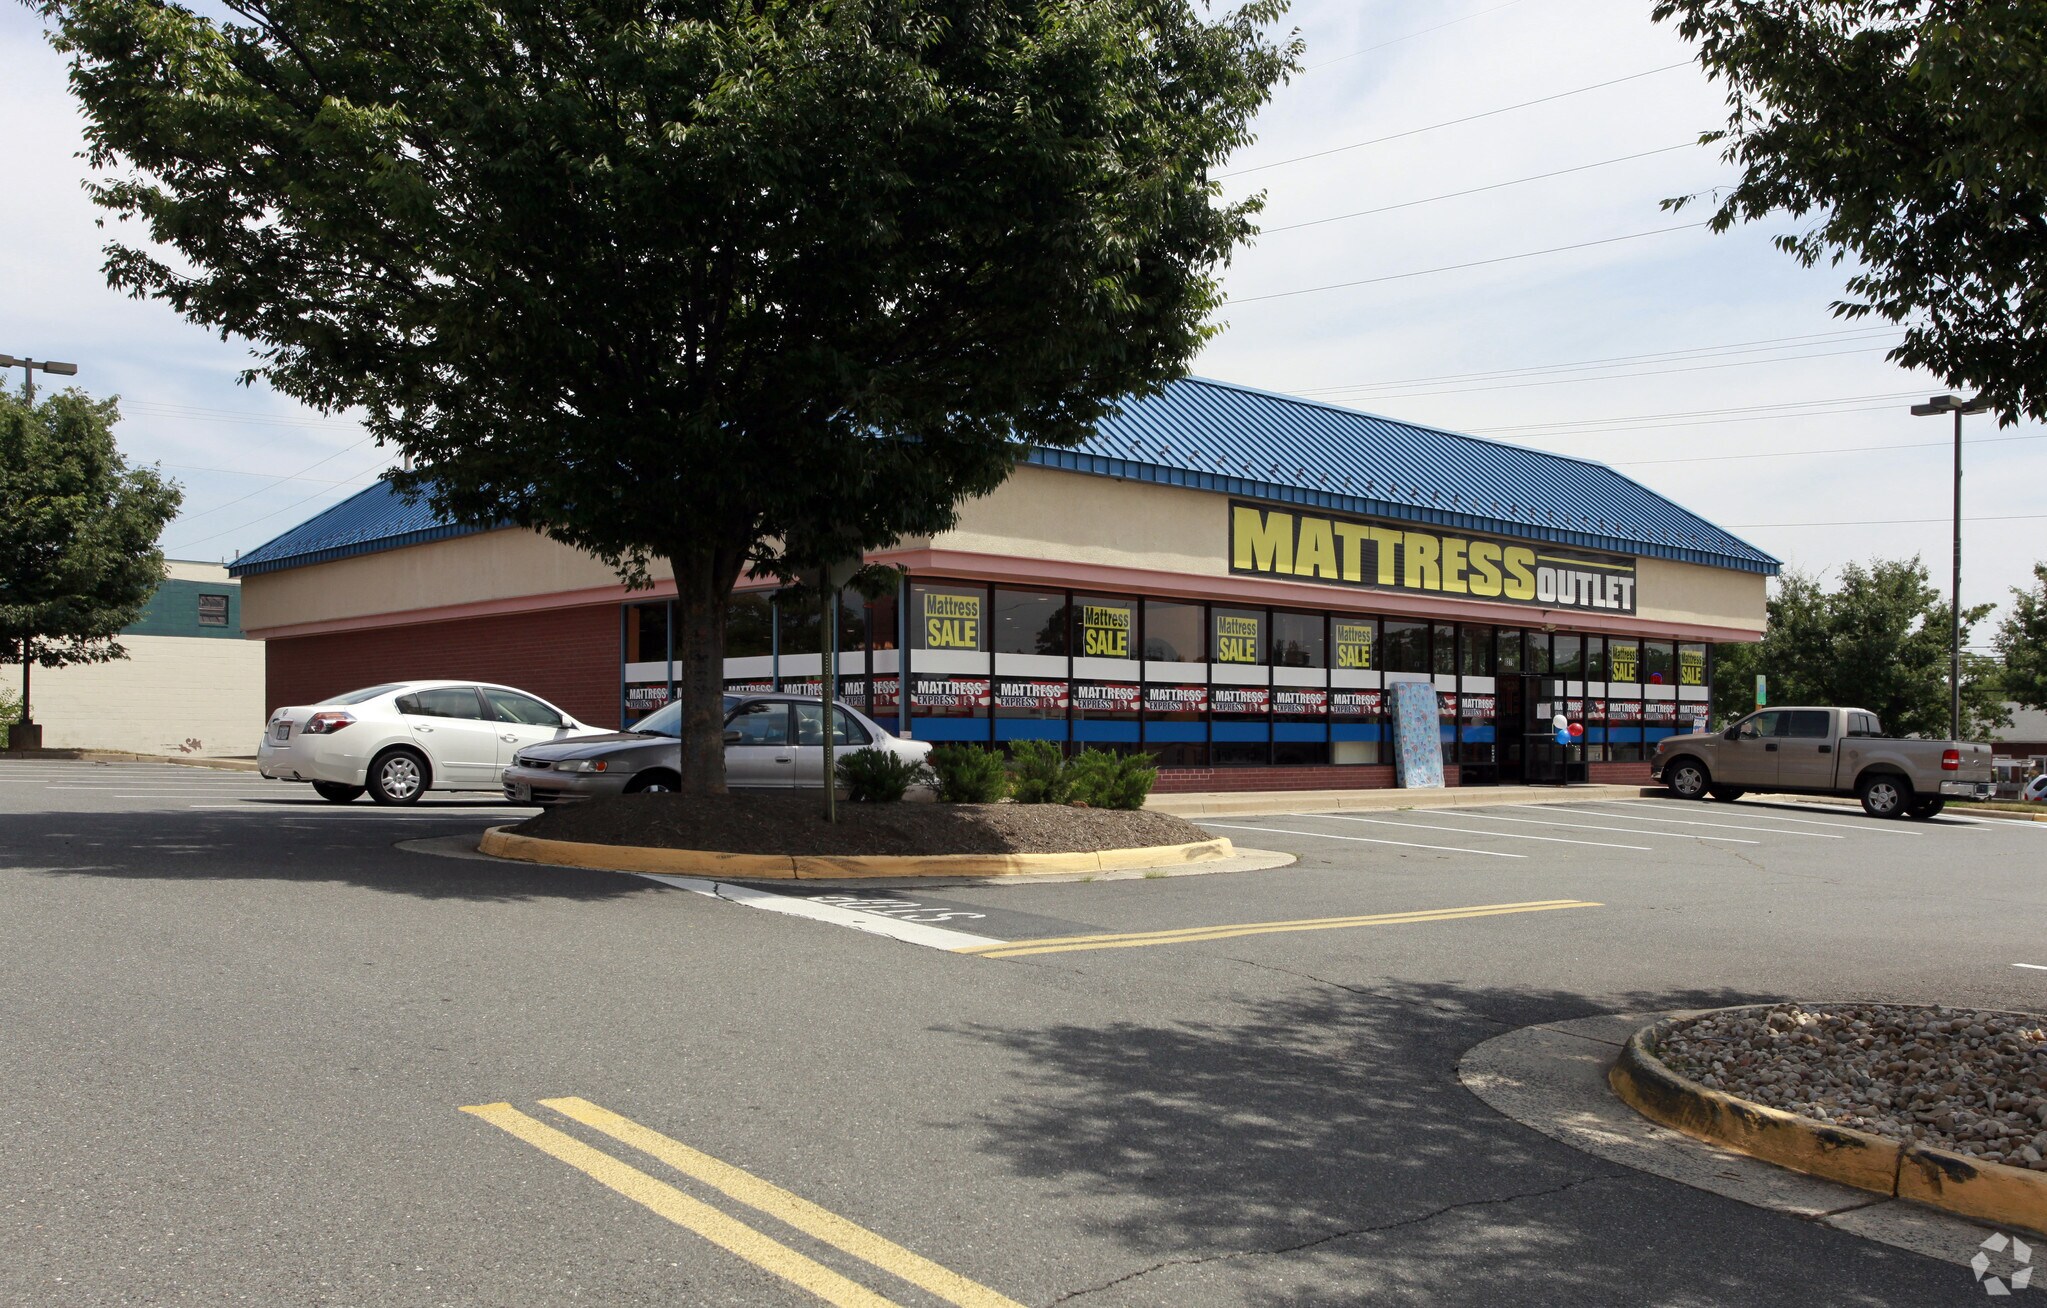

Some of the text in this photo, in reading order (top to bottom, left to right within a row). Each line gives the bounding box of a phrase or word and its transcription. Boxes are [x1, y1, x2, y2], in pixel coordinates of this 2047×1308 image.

[1233, 506, 1634, 610] MATTRESS OUTLET
[927, 594, 978, 616] Mattress
[1085, 606, 1129, 628] Mattress
[1218, 616, 1257, 635] Mattress
[928, 618, 976, 647] SALE
[1337, 626, 1370, 642] Mattress
[1085, 629, 1127, 656] SALE
[1219, 637, 1256, 662] SALE
[1338, 645, 1370, 667] SALE
[1613, 646, 1636, 660] Mattress
[1613, 662, 1635, 681] SALE
[629, 688, 667, 700] MATTRESS
[784, 683, 823, 696] MATTRES
[845, 680, 896, 695] MATRESS
[917, 680, 983, 695] MATTRESS
[1000, 683, 1061, 697] MATTRESS
[1078, 686, 1134, 700] MATTRESS
[917, 695, 956, 706] EXPRESS
[1149, 688, 1202, 701] MATTRESS
[1215, 690, 1264, 702] MATTRESS
[1276, 692, 1322, 704] MATTRESS
[1334, 694, 1376, 705] MATTRESS
[1000, 697, 1037, 707] EXPRESS
[1078, 699, 1111, 709] EXPRESS
[1149, 701, 1181, 711] EXPRESS
[1215, 702, 1244, 712] EXPRESS
[1276, 704, 1304, 713] EXPRESS
[1462, 698, 1493, 709] MATTRESS
[1609, 703, 1638, 712] MATTRESS
[1645, 704, 1674, 713] MATTRESS
[1680, 704, 1706, 714] MATTRESS
